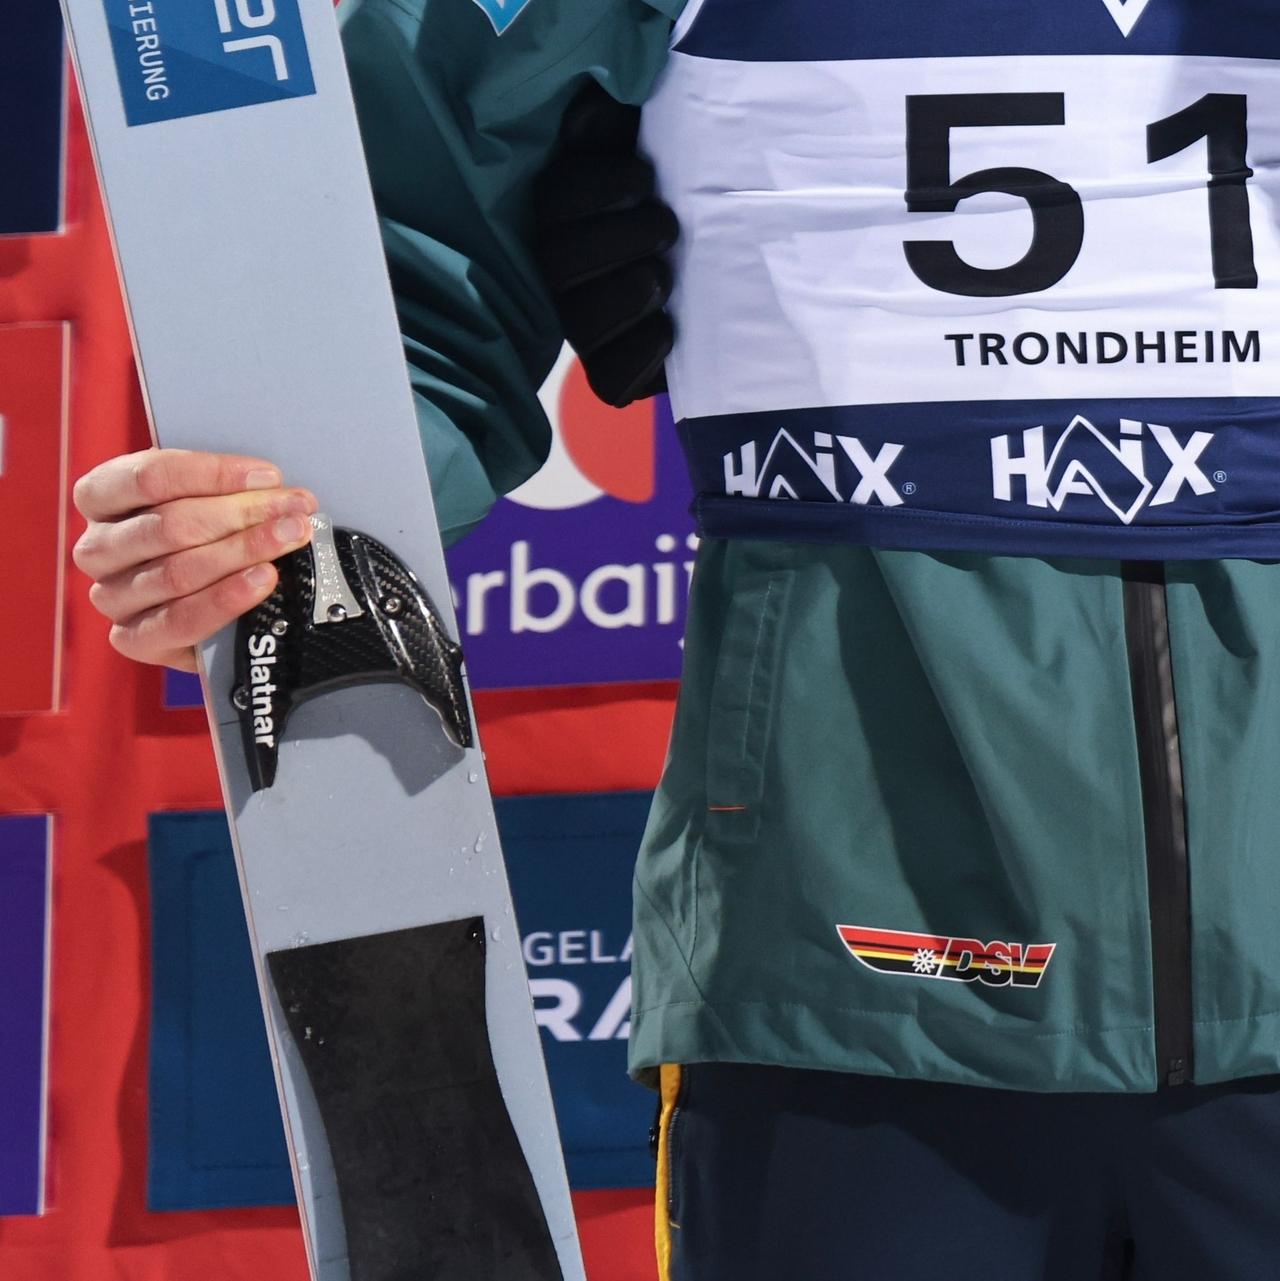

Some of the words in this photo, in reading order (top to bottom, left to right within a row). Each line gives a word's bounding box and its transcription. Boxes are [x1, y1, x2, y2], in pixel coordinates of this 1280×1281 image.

[902, 91, 1259, 298] 51
[944, 328, 1262, 367] TRONDHEIM
[248, 633, 276, 748] Slatnar
[938, 937, 1057, 989] DSV
